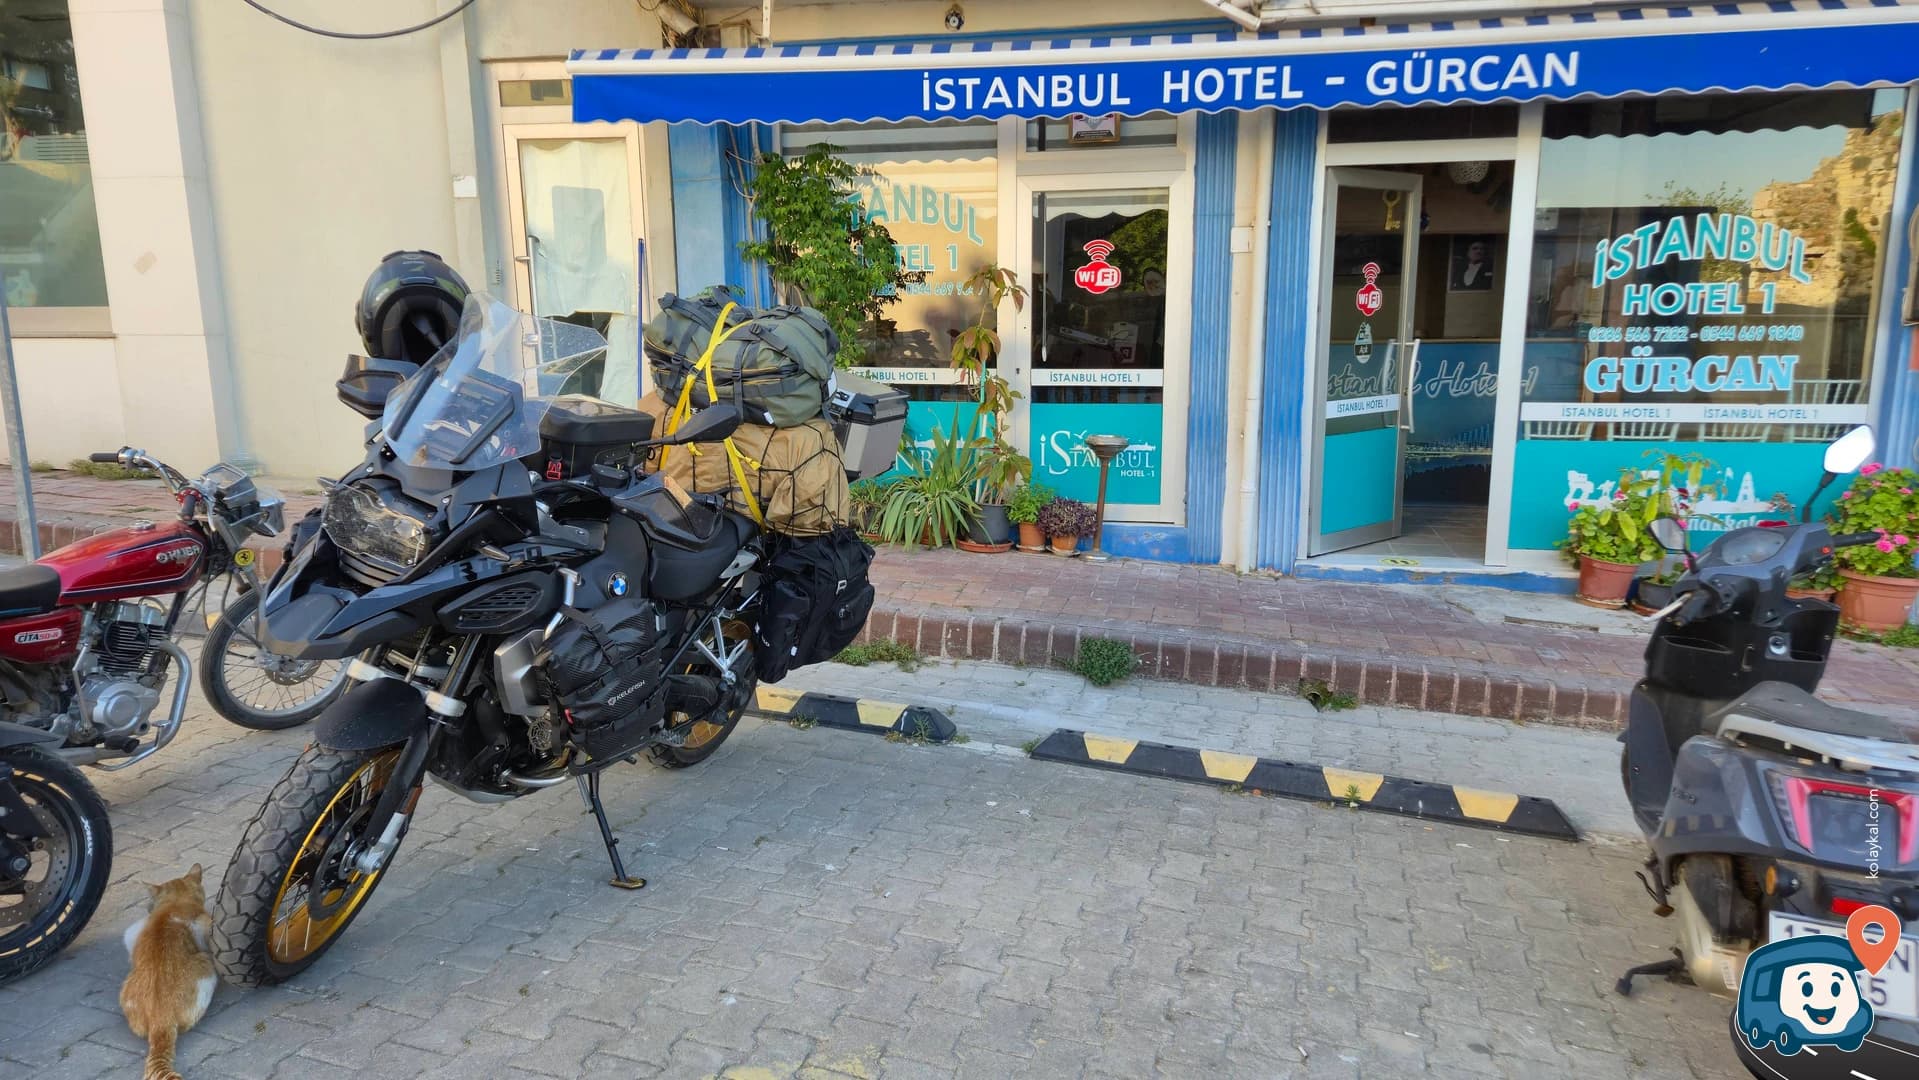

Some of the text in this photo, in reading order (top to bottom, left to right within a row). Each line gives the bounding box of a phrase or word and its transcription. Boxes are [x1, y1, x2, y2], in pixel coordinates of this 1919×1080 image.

[922, 72, 1131, 111] İSTANBUL
[1162, 64, 1303, 104] HOTEL
[1365, 51, 1579, 97] GÜRCAN
[838, 184, 984, 247] TANBUL
[856, 243, 958, 273] TEL 1
[1592, 213, 1813, 289] İSTANBUL
[1621, 282, 1776, 316] HOTEL 1
[1625, 326, 1651, 343] 566
[1700, 325, 1736, 342] 0544
[1738, 325, 1765, 342] 669
[1767, 325, 1804, 342] 9840
[899, 372, 928, 381] HOTEL
[1049, 371, 1097, 383] İSTANBUL
[1100, 373, 1132, 383] HOTEL
[1425, 359, 1498, 398] Hote
[1583, 346, 1799, 393] GÜRCAN
[1622, 407, 1660, 419] HOTEL
[1768, 408, 1807, 419] HOTEL
